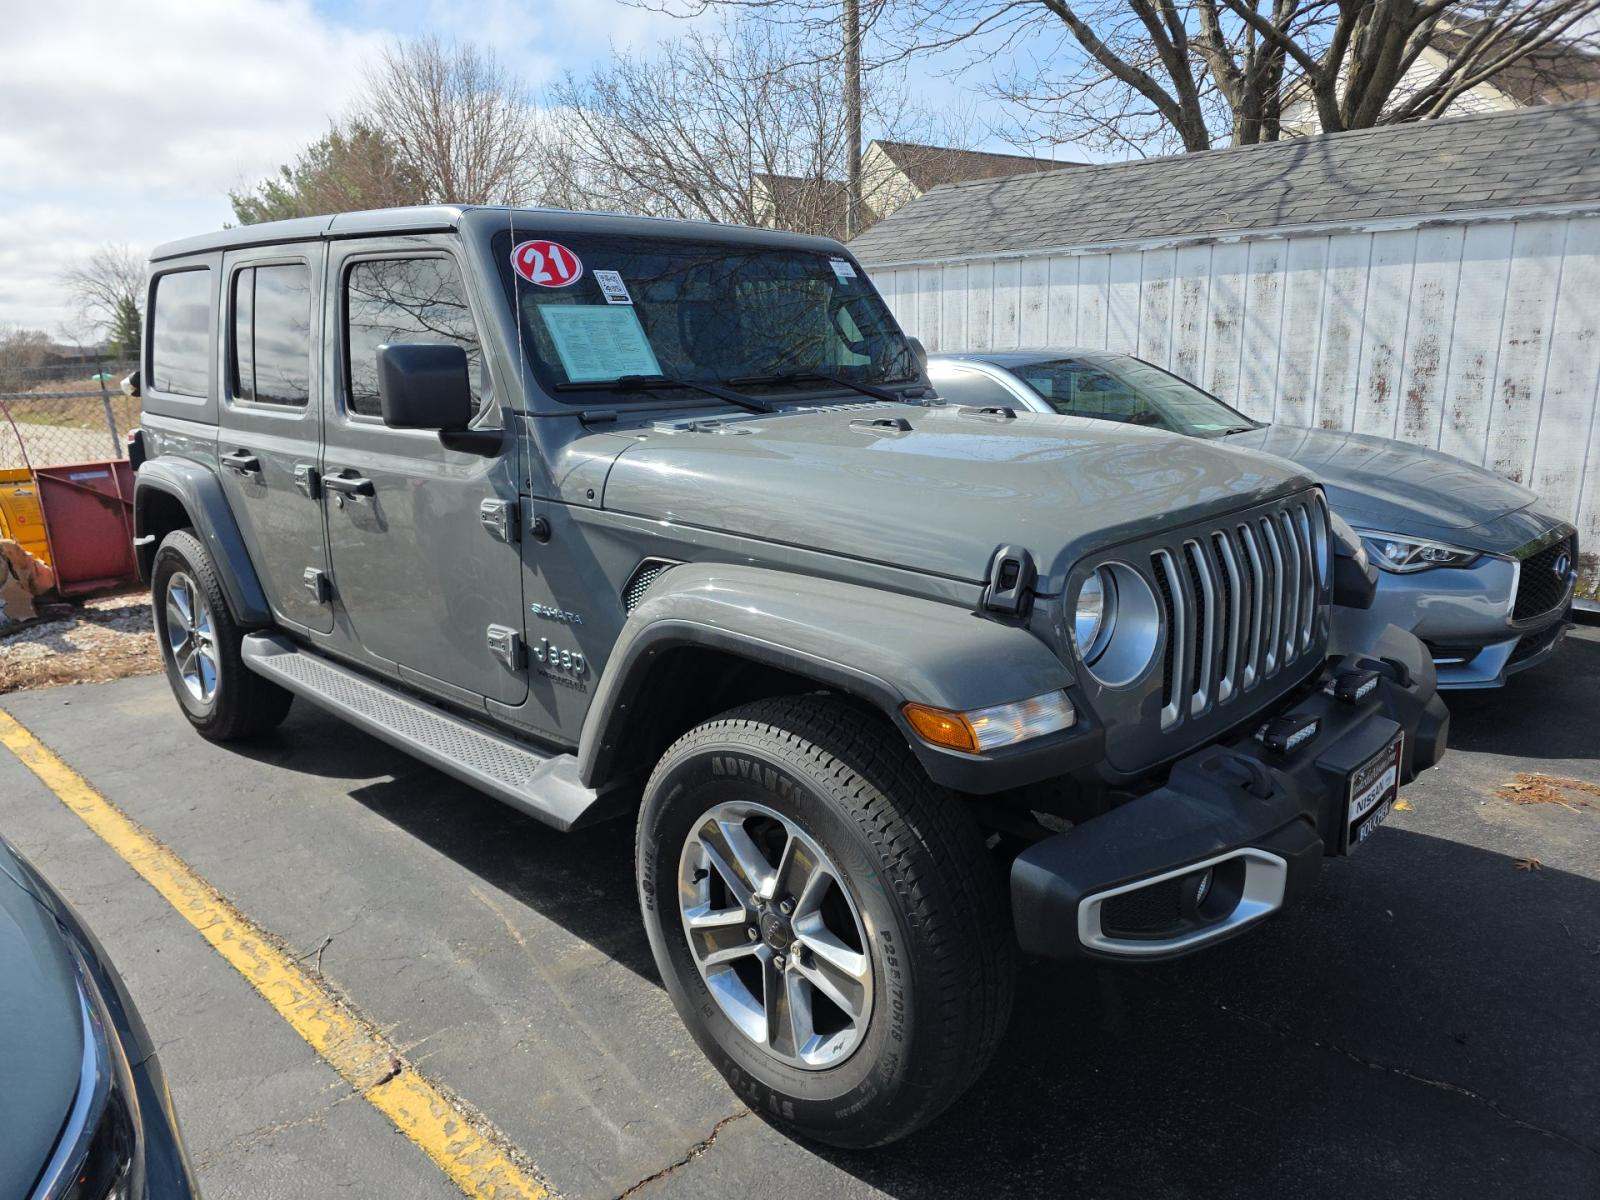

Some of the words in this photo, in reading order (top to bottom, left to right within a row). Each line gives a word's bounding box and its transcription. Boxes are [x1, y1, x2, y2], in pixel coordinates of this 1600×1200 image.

[523, 245, 567, 282] 21
[531, 602, 583, 625] SAHARA
[533, 637, 585, 674] Jeep
[1355, 781, 1385, 815] NISSAN
